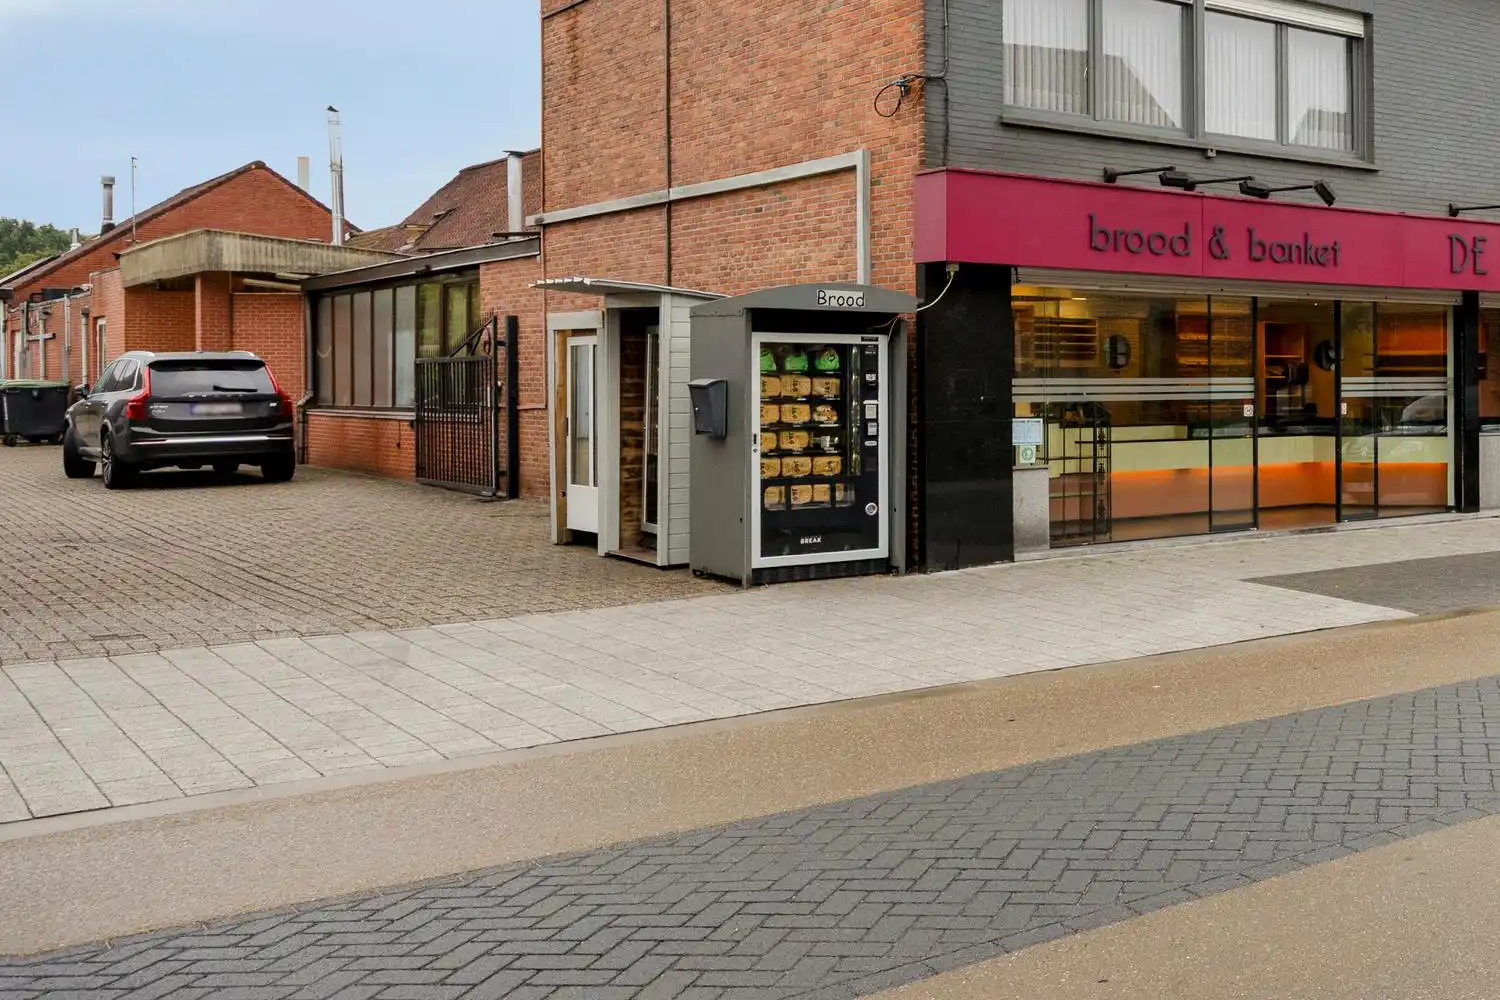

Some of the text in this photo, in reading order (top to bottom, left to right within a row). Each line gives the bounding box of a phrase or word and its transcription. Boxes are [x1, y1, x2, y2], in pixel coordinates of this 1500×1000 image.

[1087, 212, 1341, 268] brood & banket
[1448, 233, 1488, 275] DE
[817, 289, 865, 307] Brood
[800, 537, 822, 545] BREAK
